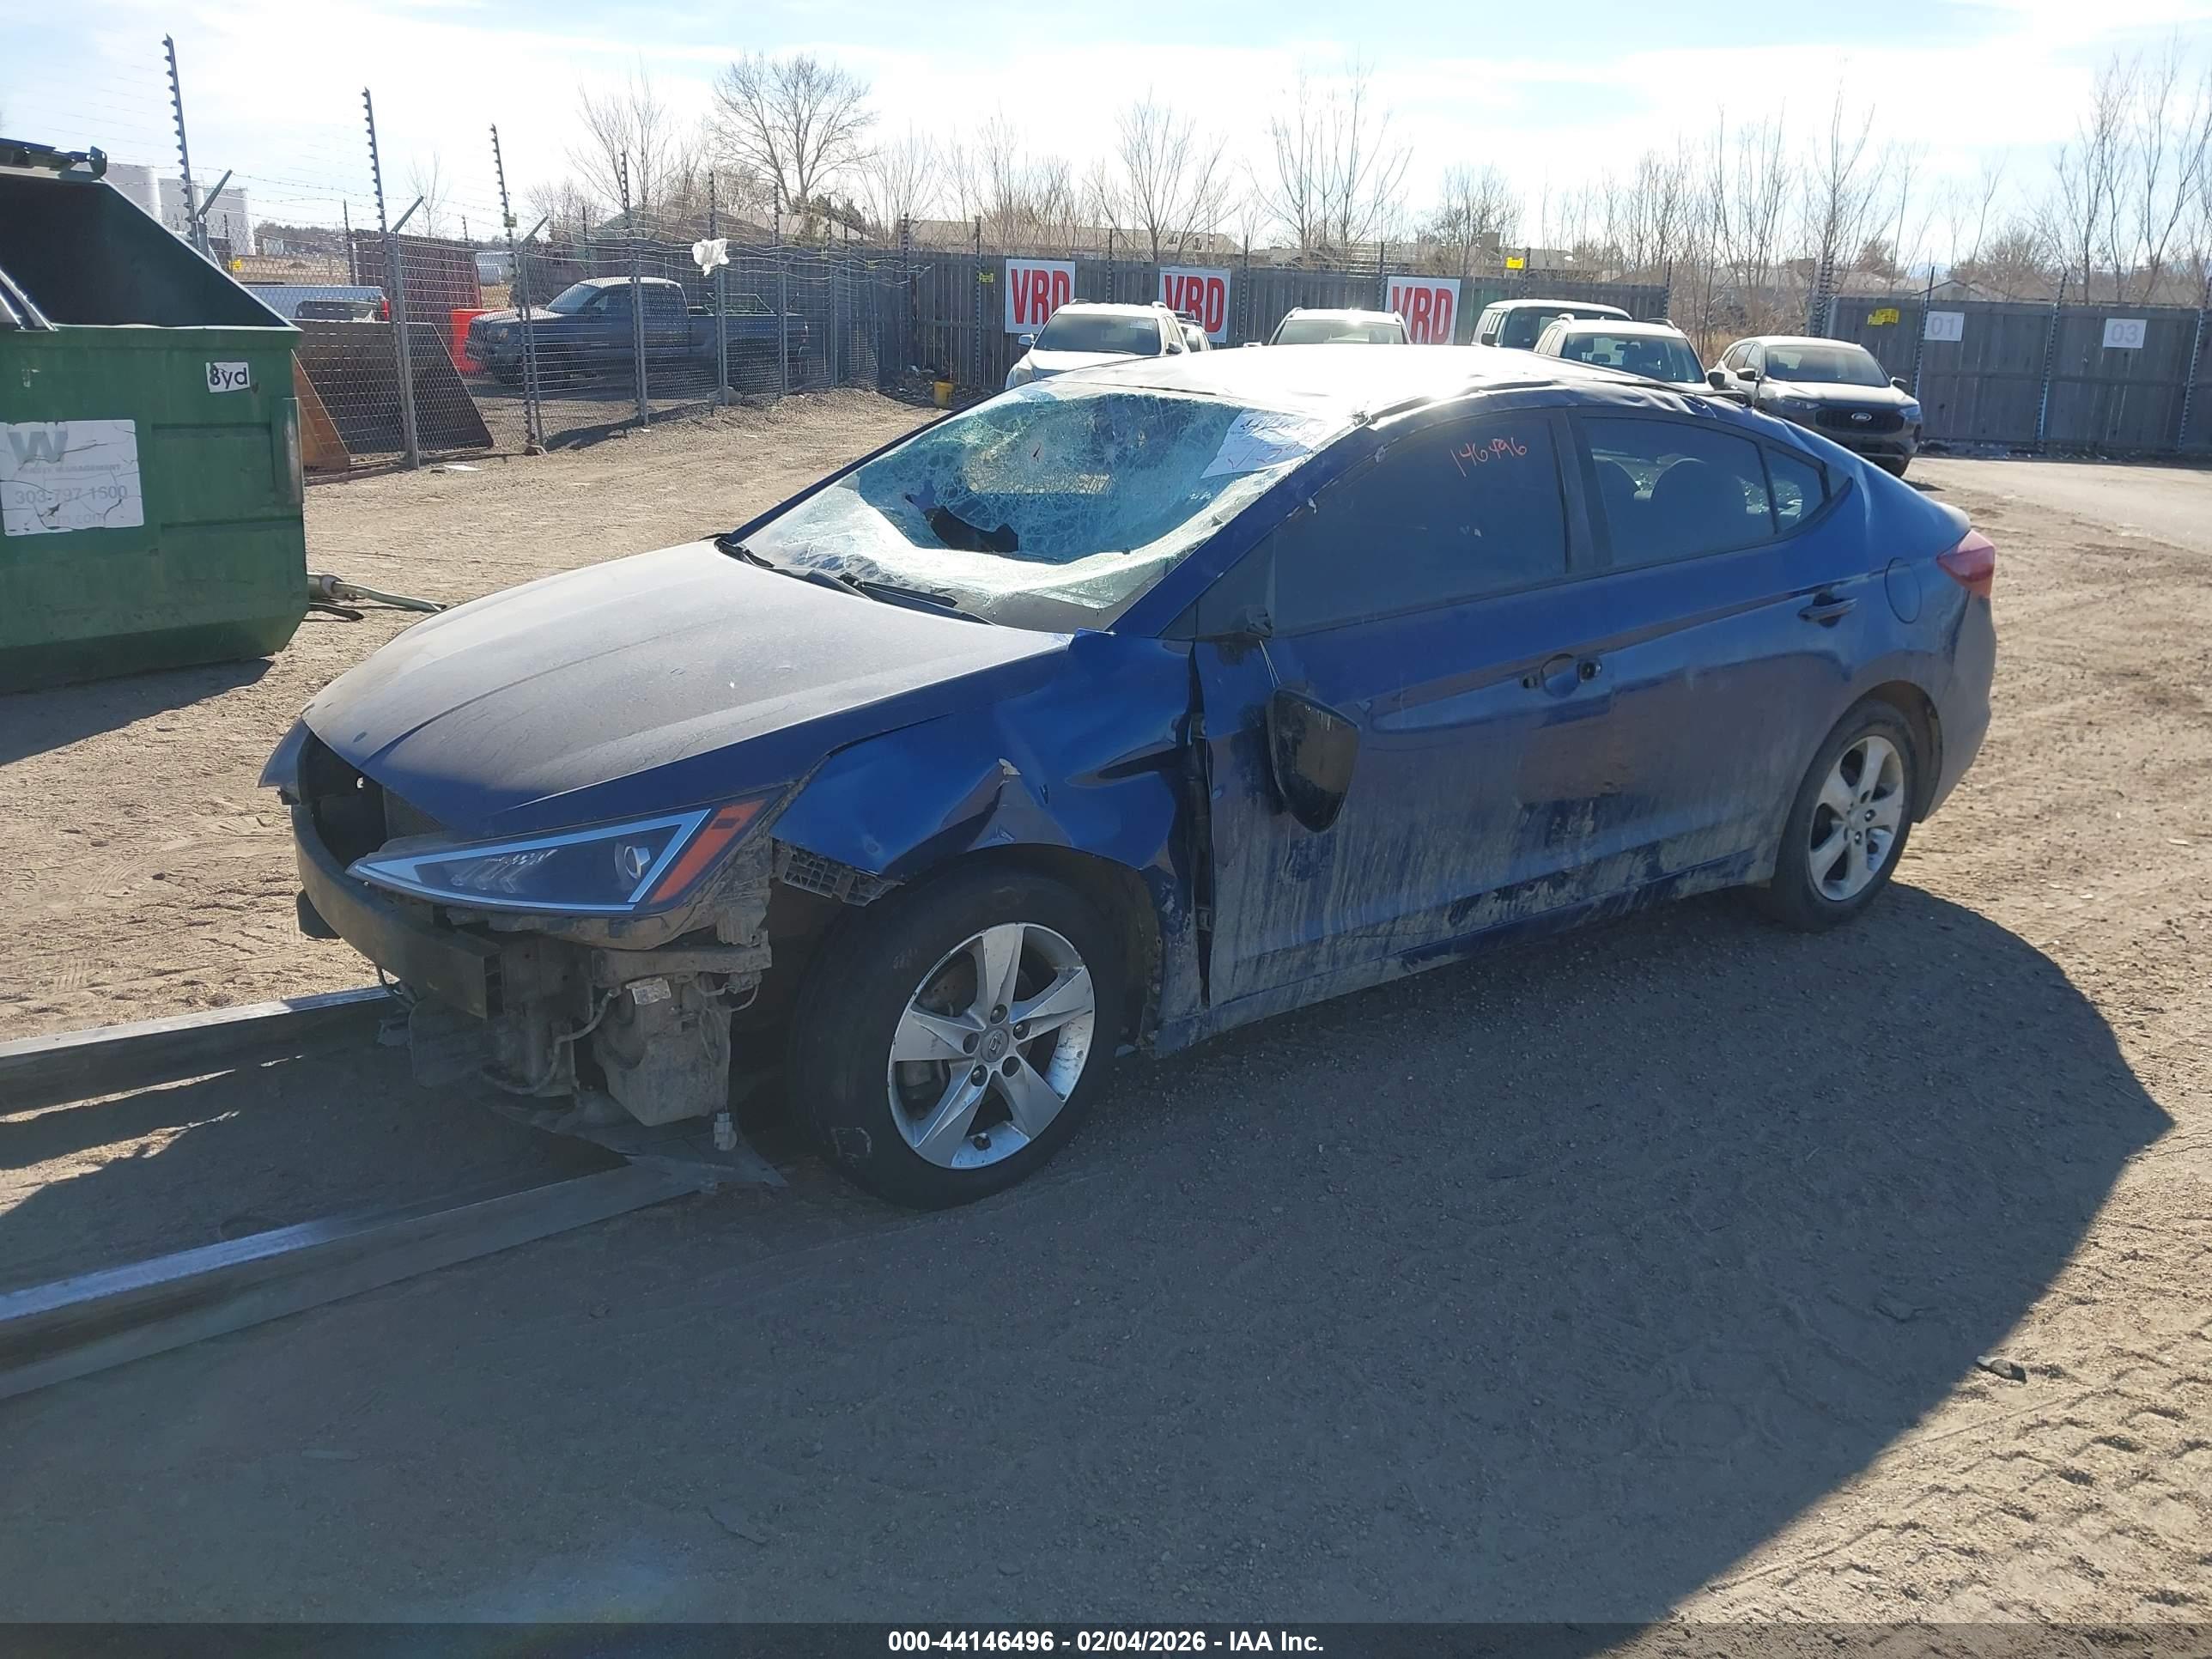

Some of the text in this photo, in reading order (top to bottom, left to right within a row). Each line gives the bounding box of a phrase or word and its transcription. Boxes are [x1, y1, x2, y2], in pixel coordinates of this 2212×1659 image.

[1011, 269, 1071, 325] VRD
[1165, 275, 1225, 333] VRD
[1393, 286, 1453, 344] VRD
[1931, 315, 1955, 336] 01
[2112, 323, 2138, 344] 03
[210, 367, 248, 390] 8yd
[1449, 436, 1528, 478] 146496
